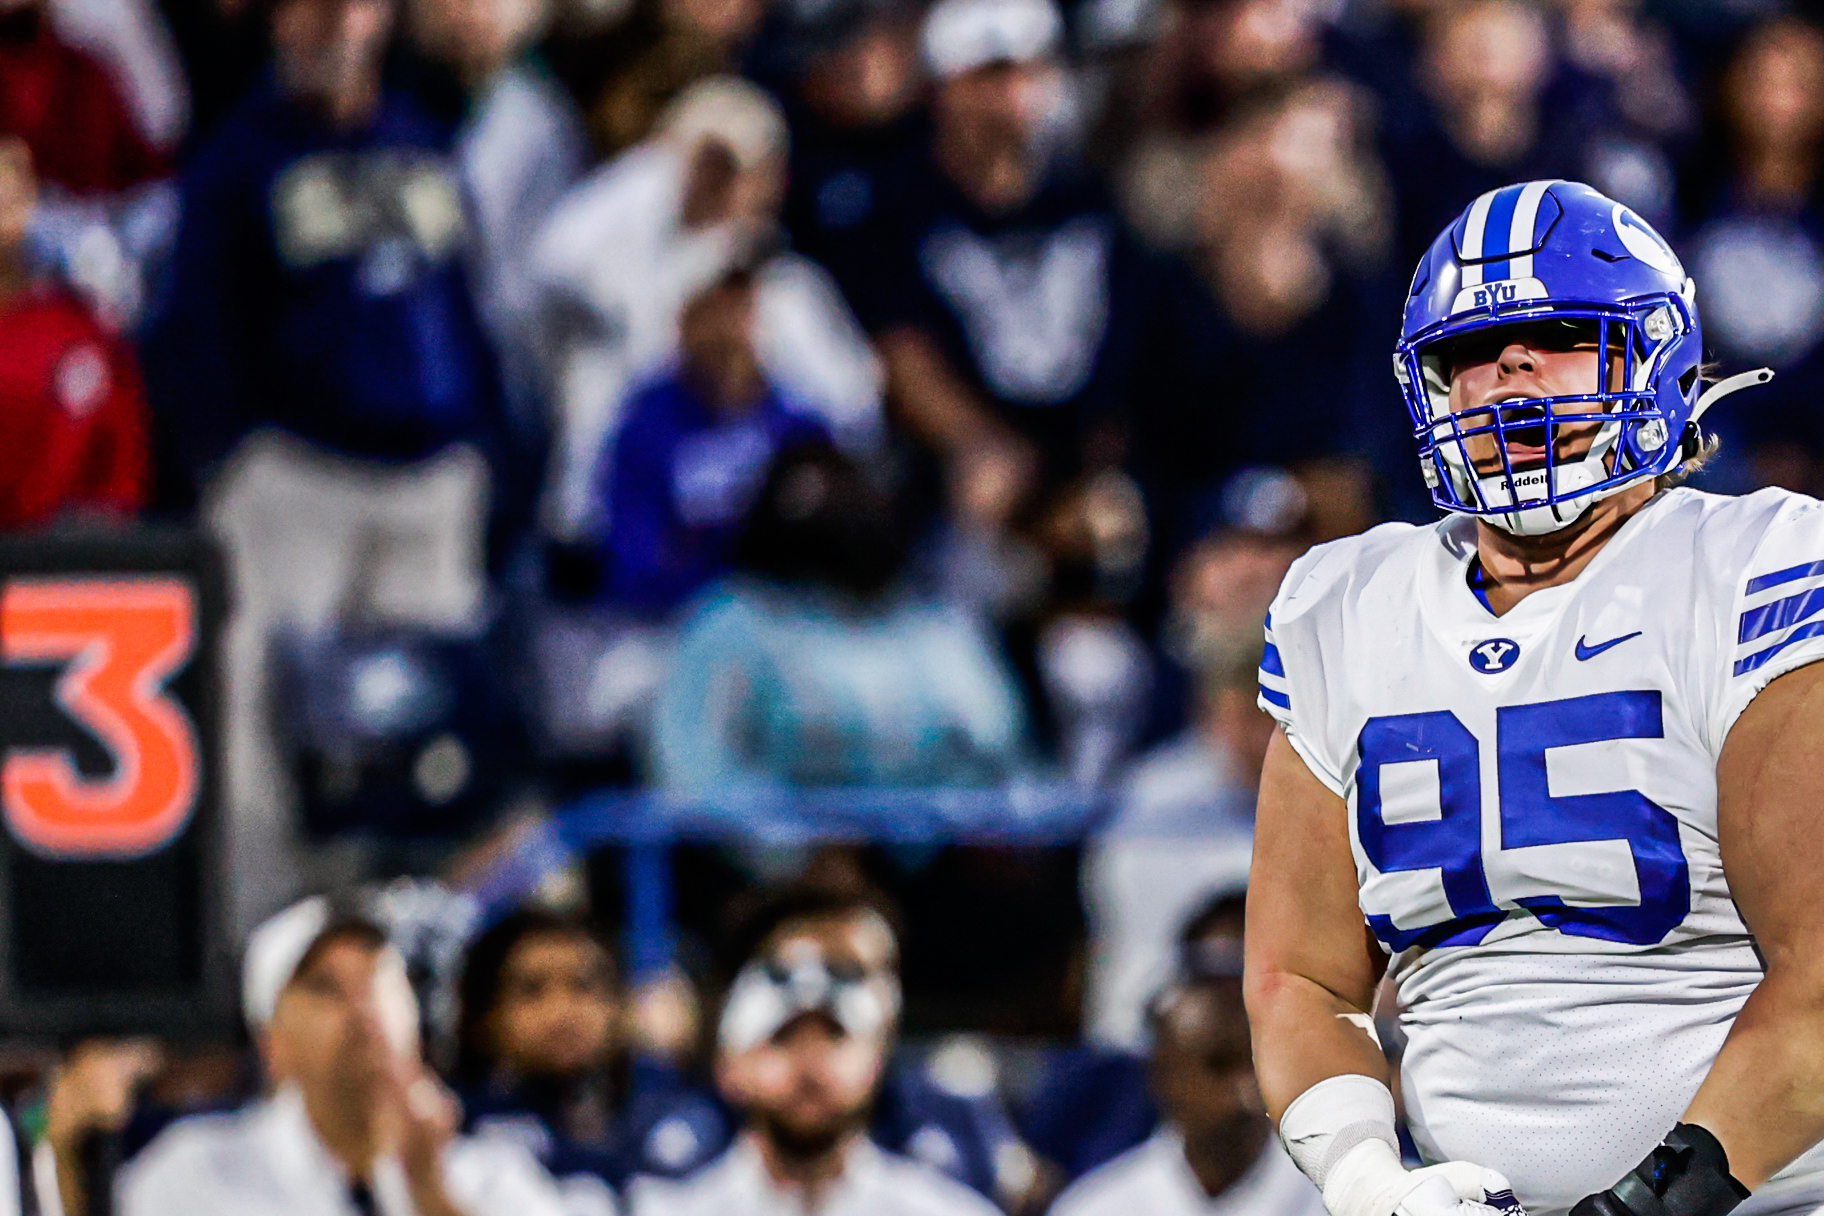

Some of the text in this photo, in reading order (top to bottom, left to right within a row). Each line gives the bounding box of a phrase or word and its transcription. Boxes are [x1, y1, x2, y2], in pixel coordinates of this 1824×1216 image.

[1474, 283, 1516, 307] BYU
[0, 575, 201, 862] 3
[1356, 690, 1691, 954] 95
